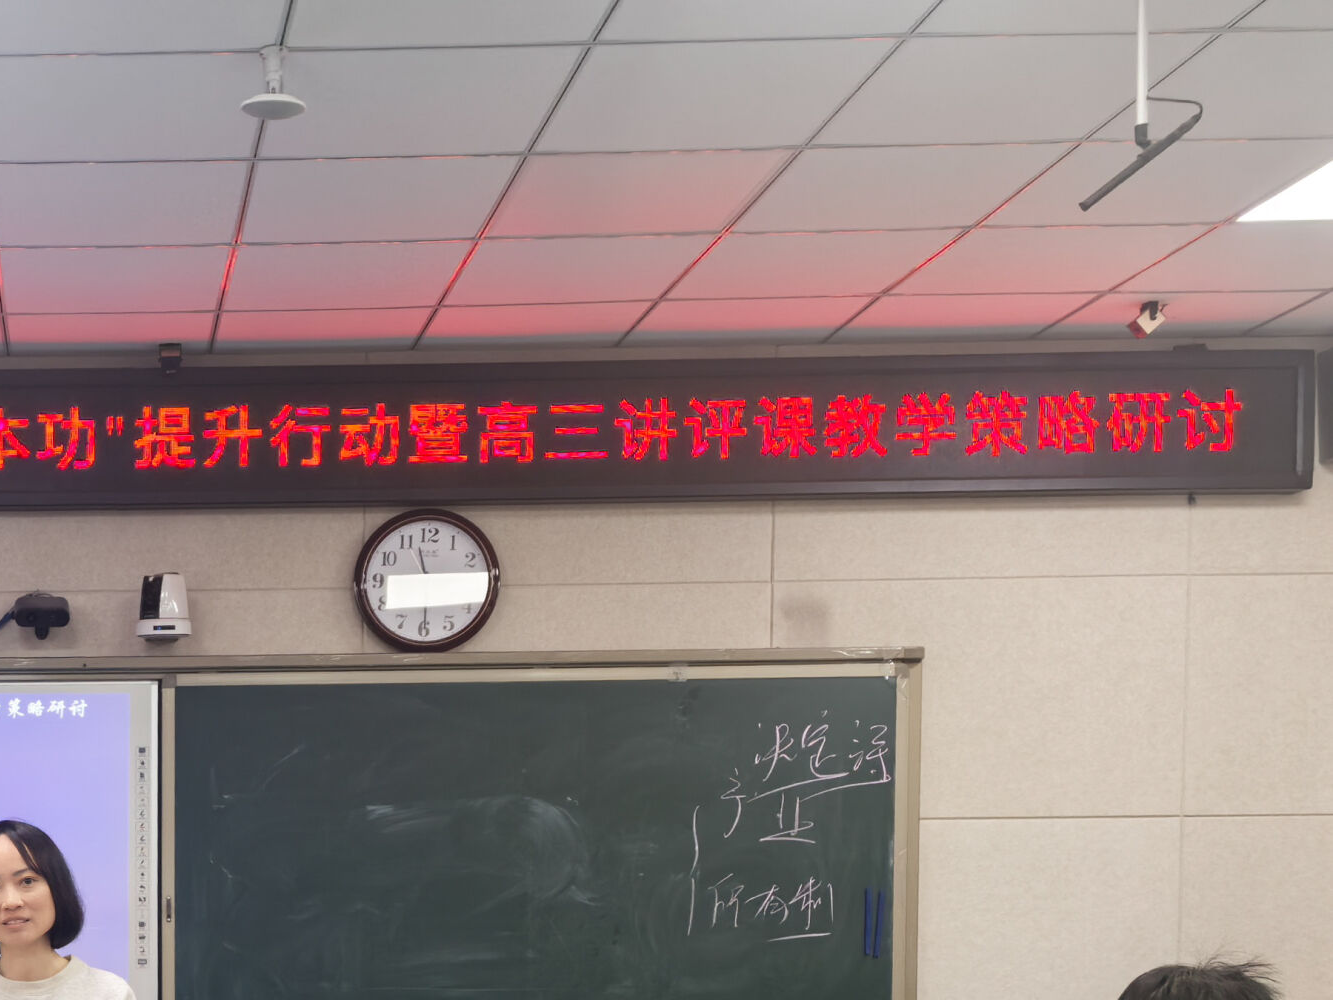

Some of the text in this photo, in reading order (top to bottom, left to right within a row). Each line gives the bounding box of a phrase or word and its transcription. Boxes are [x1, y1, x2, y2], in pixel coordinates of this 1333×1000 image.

[400, 535, 413, 549] 11
[421, 528, 439, 543] 12
[450, 535, 456, 550] 1
[381, 551, 397, 566] 10
[465, 552, 476, 568] 2
[372, 573, 384, 588] 9
[396, 614, 407, 629] 7
[418, 621, 430, 637] 6
[443, 616, 455, 631] 5
